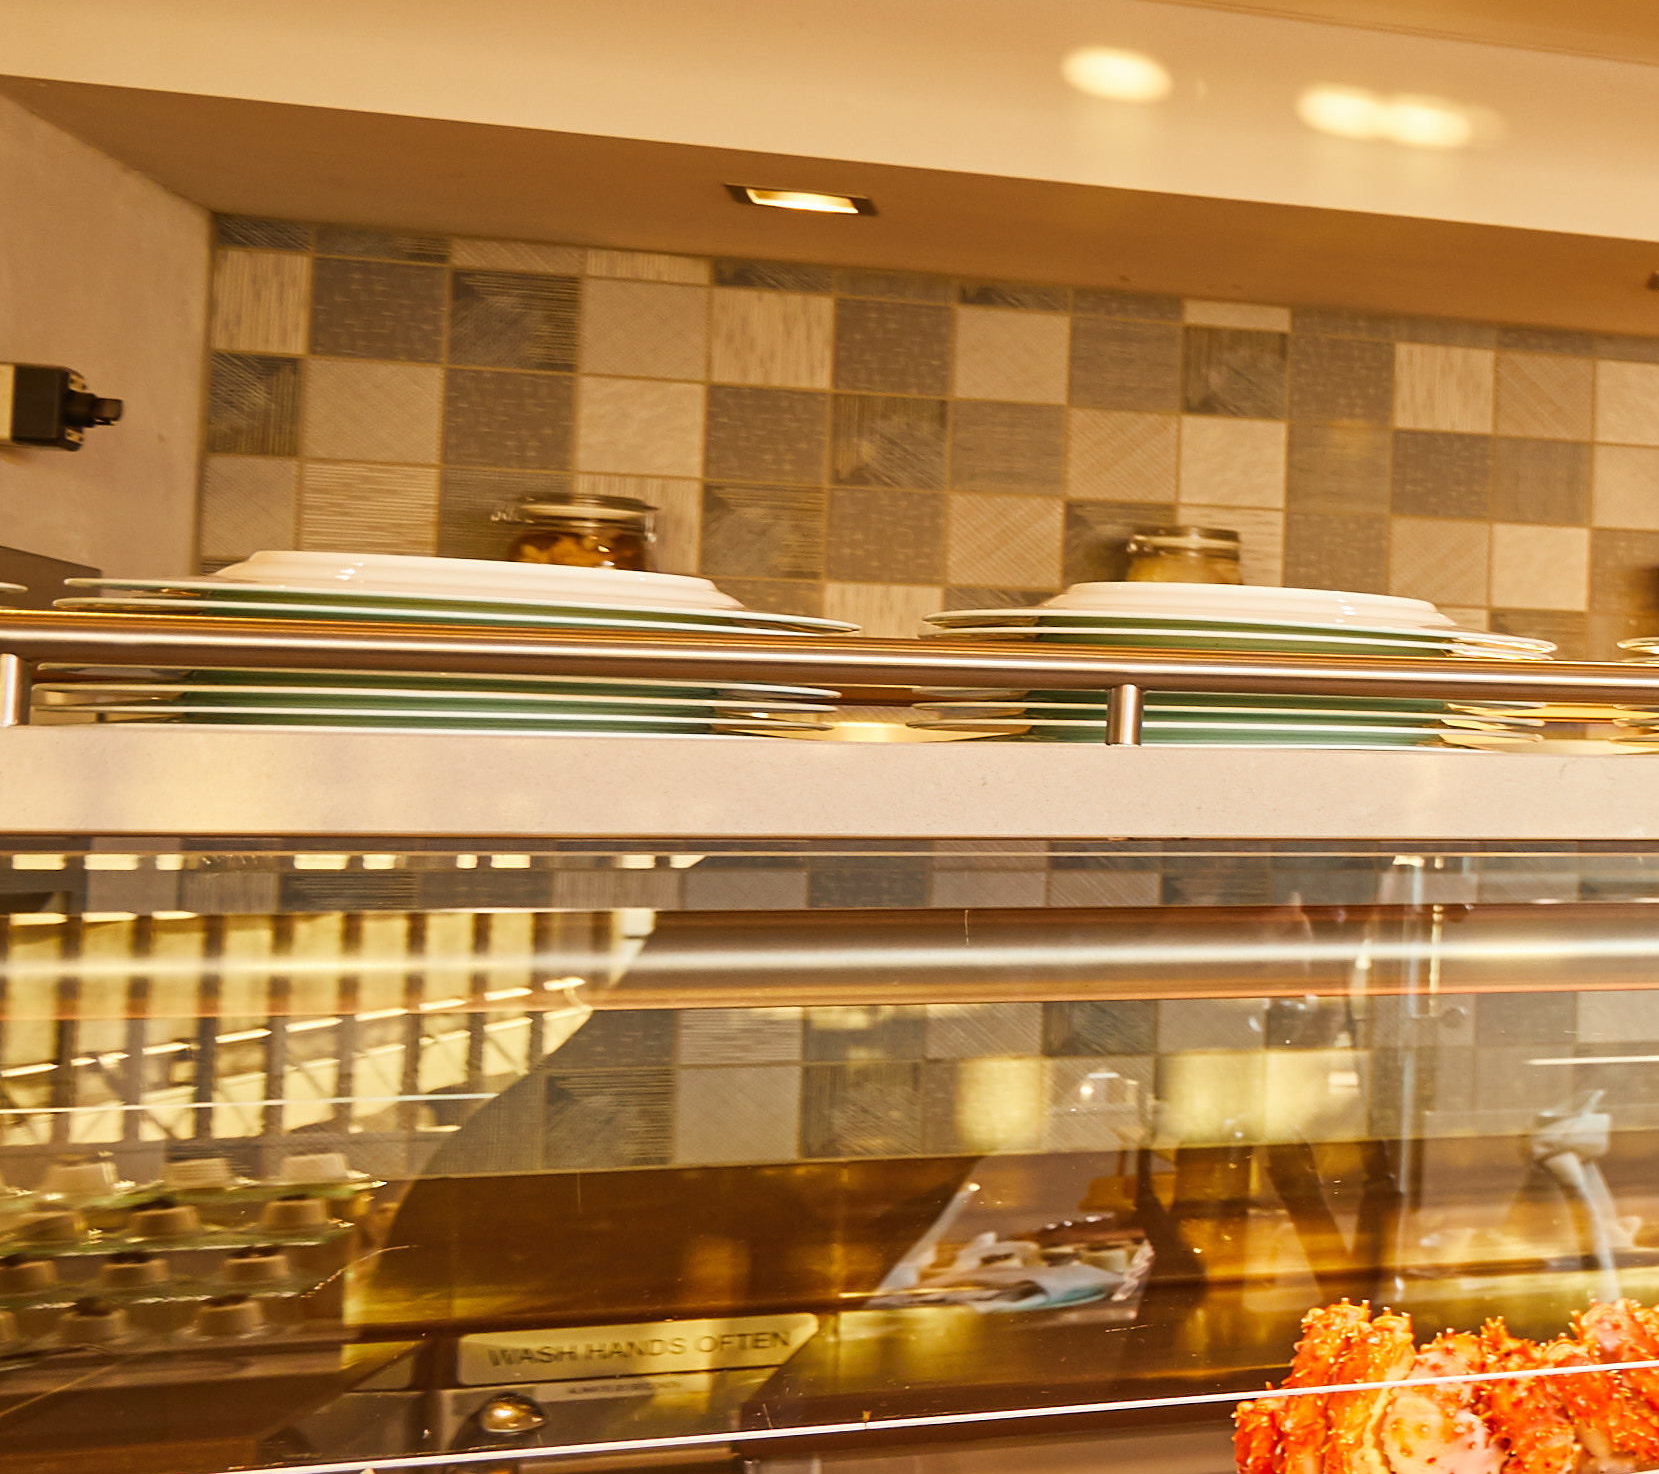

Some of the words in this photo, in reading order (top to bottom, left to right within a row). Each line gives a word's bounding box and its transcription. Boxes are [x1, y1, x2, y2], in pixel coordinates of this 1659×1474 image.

[488, 1344, 579, 1367] WASH
[585, 1337, 687, 1361] HANDS
[696, 1330, 790, 1354] OFTEN
